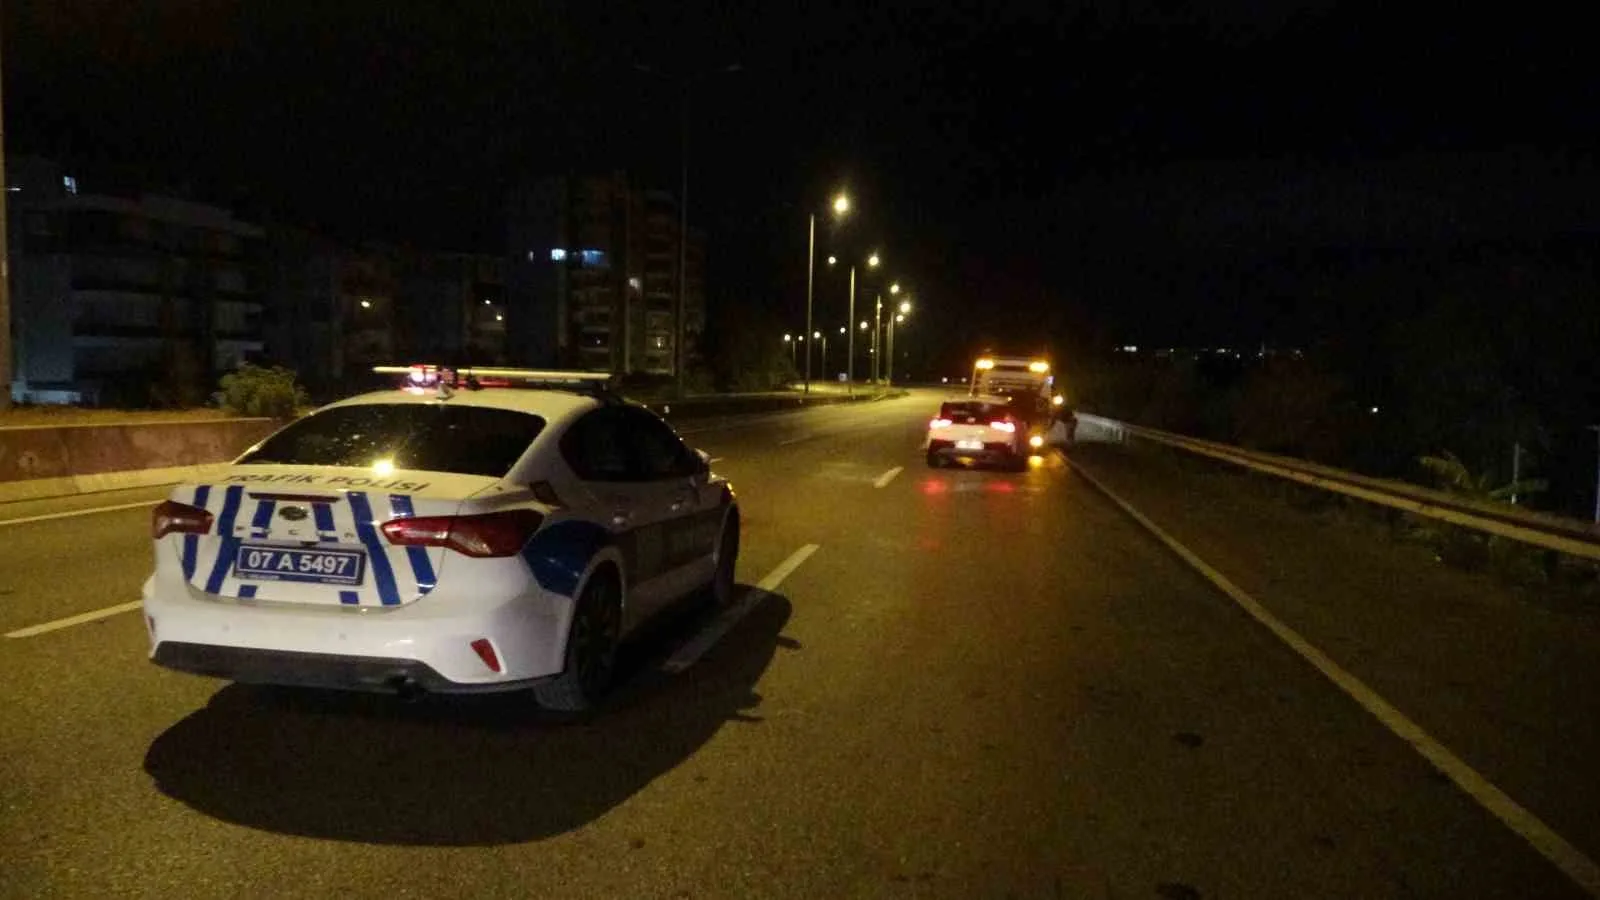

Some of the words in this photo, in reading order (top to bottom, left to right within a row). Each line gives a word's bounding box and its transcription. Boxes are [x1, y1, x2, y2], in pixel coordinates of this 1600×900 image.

[248, 551, 274, 568] 07
[277, 553, 294, 570] A
[300, 554, 349, 574] 5497
